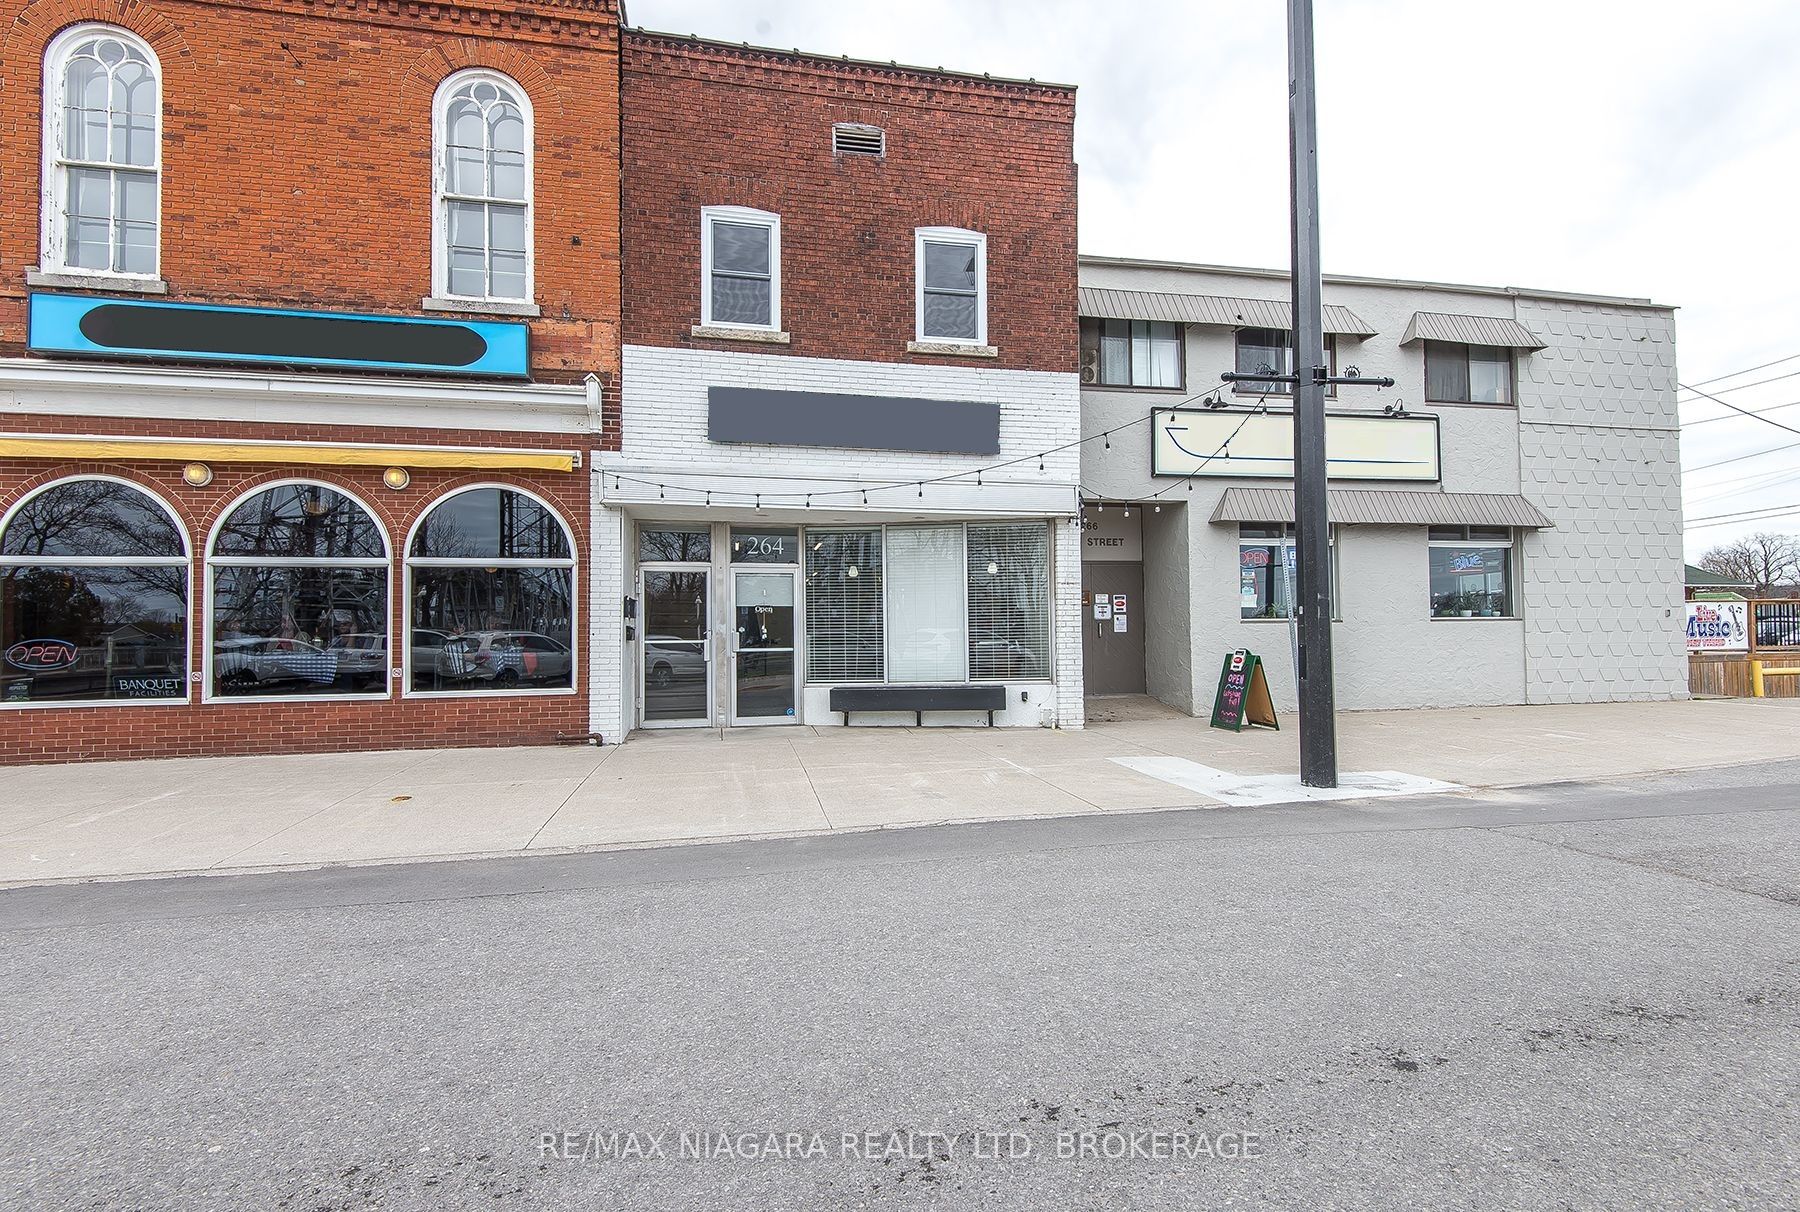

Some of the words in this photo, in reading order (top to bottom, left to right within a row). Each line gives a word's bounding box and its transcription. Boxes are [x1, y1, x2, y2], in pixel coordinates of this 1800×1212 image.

[747, 536, 785, 555] 264
[1087, 537, 1125, 547] STREET
[1240, 552, 1269, 564] OPEN
[754, 605, 773, 614] Open
[8, 646, 78, 663] OPEN
[118, 678, 181, 691] BANQUET
[1228, 673, 1246, 685] OPEN
[129, 689, 177, 697] FACILITIES
